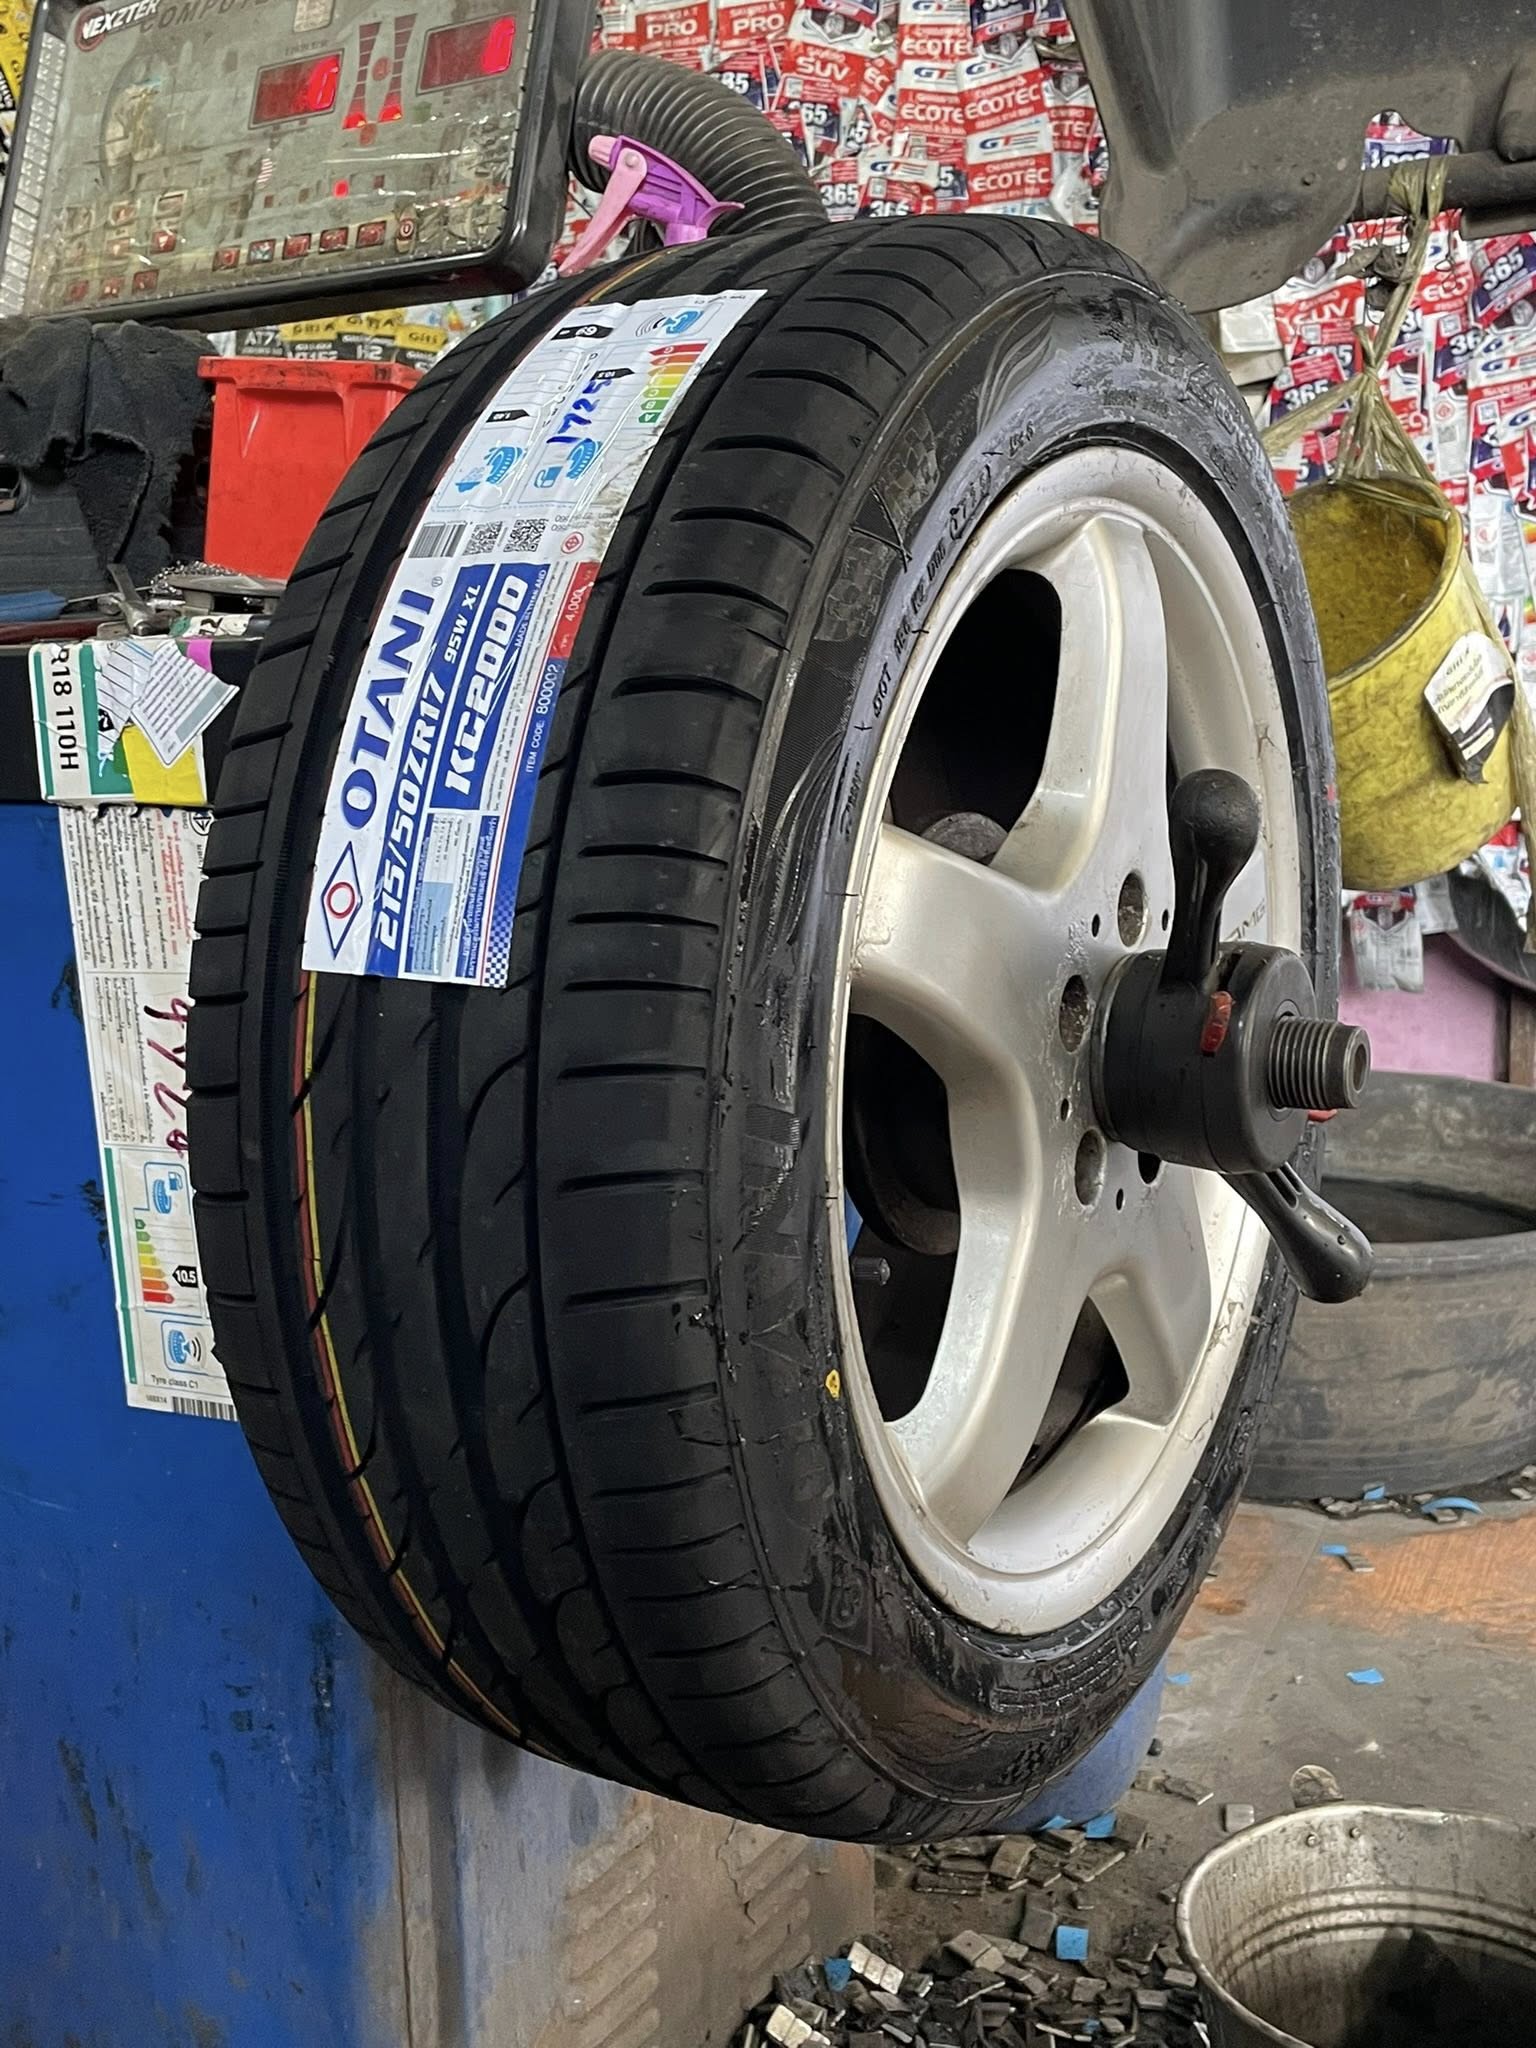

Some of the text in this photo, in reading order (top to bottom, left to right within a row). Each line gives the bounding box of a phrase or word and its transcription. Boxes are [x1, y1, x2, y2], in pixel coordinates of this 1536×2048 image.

[646, 18, 698, 39] PRO
[732, 13, 785, 36] PRO
[796, 56, 849, 80] SUV
[711, 71, 750, 95] 65
[901, 102, 965, 124] ECOTE
[964, 83, 1041, 119] ECOTEC
[972, 167, 1051, 192] ECOTEC
[820, 183, 860, 208] 365
[1482, 246, 1525, 292] 365
[1449, 328, 1484, 357] 36
[514, 621, 529, 649] MADE
[444, 573, 529, 796] KC2000
[340, 587, 437, 831] OTANI
[525, 749, 538, 774] ITEM
[535, 663, 563, 716] 800002
[56, 705, 80, 770] 110H
[374, 583, 482, 953] 215/50ZR17 95W XL
[175, 1268, 198, 1284] 10.5
[151, 1374, 199, 1389] Tyre class C1
